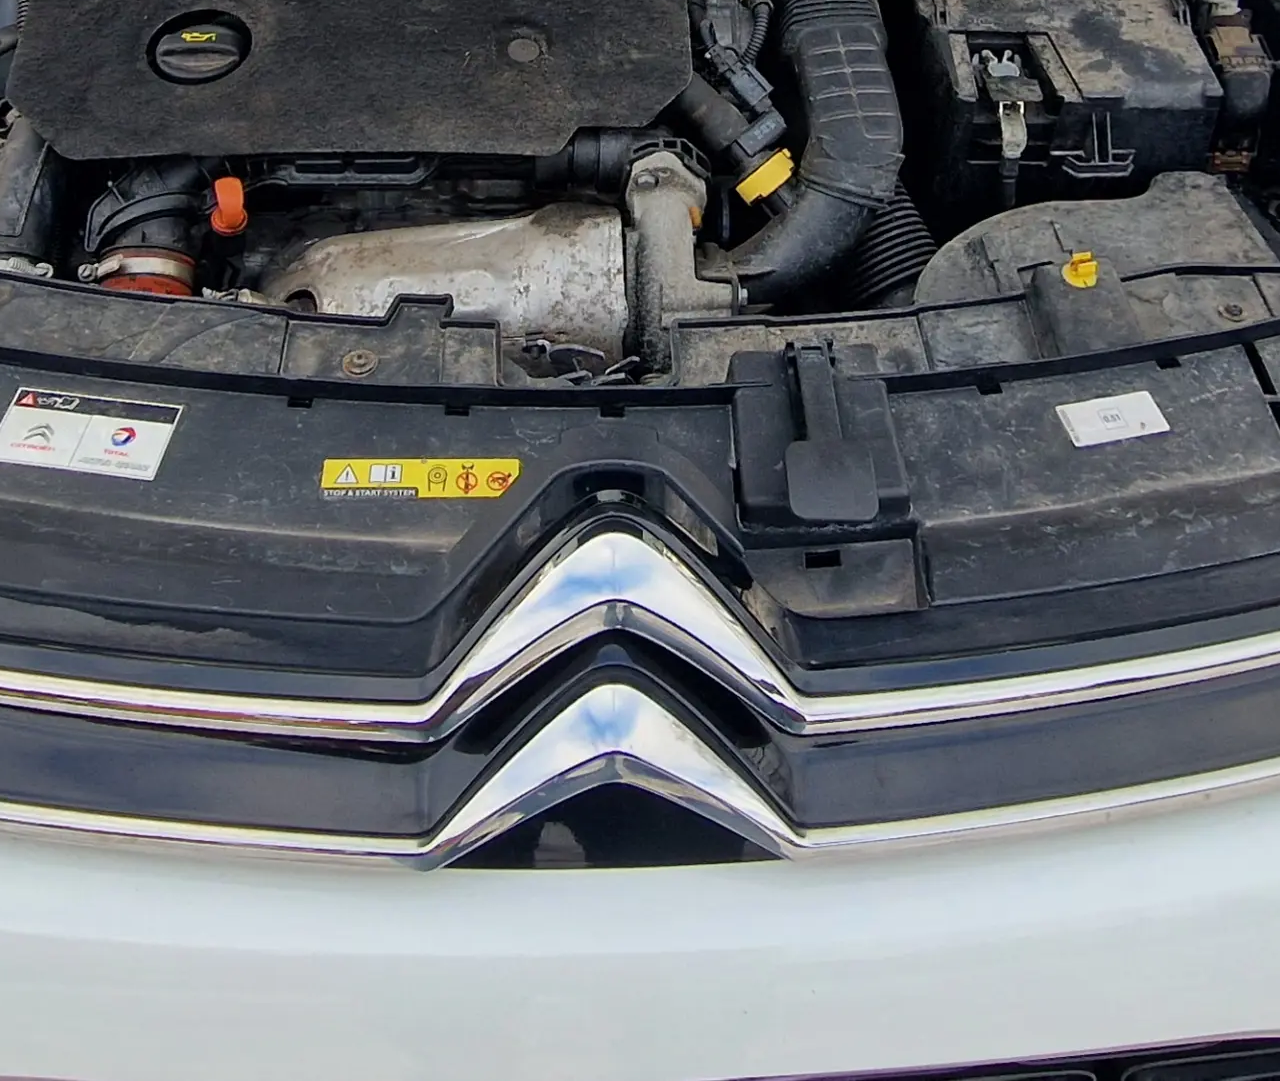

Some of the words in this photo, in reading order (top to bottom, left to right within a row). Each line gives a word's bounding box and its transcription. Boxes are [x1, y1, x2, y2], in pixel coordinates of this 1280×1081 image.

[104, 448, 130, 458] TOTAL
[323, 489, 346, 497] STOP
[355, 489, 381, 497] START
[384, 489, 416, 497] SYSTEM
